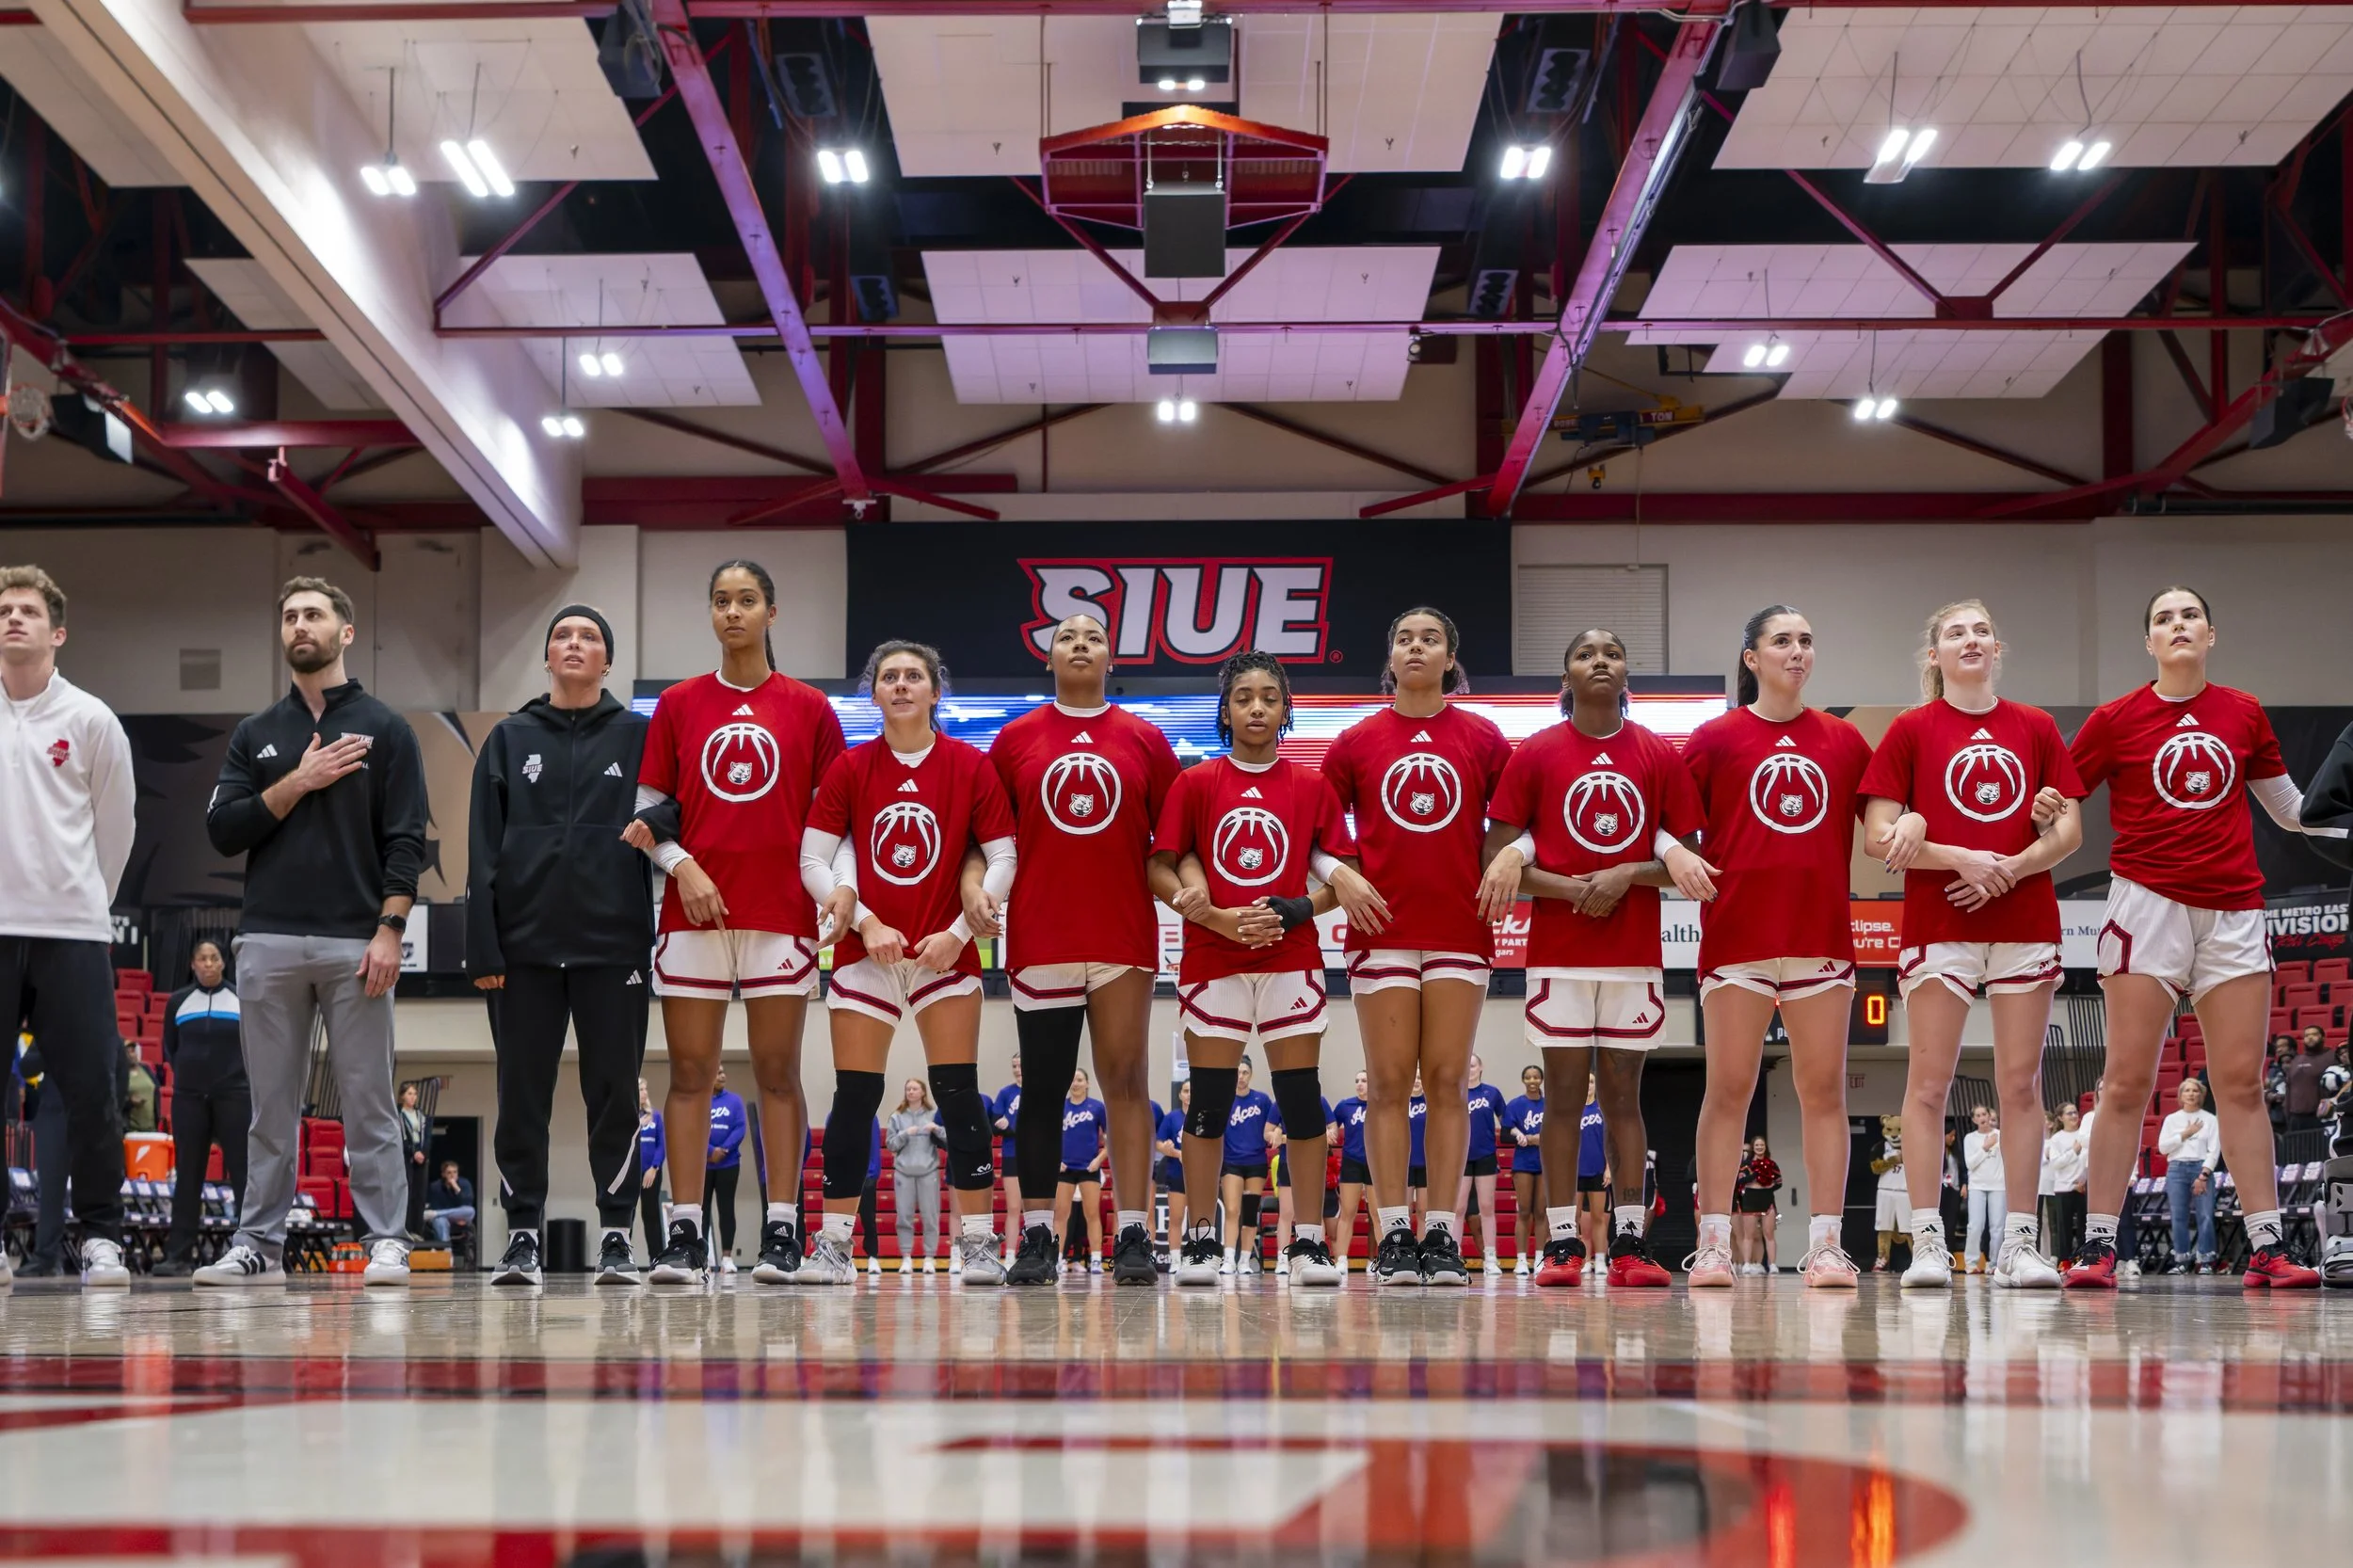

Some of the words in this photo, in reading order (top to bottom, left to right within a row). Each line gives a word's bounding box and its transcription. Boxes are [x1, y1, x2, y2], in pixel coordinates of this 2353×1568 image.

[1650, 411, 1673, 422] TON
[1026, 562, 1327, 662] SIUE
[522, 764, 543, 774] SIUE
[2281, 905, 2322, 918] METRO
[2077, 925, 2101, 936] Mu
[1887, 936, 1901, 949] C
[1866, 995, 1885, 1025] 0
[1467, 1096, 1490, 1114] ces
[1062, 1111, 1094, 1131] Aces
[1230, 1105, 1261, 1127] Aces
[1579, 1112, 1603, 1130] ces
